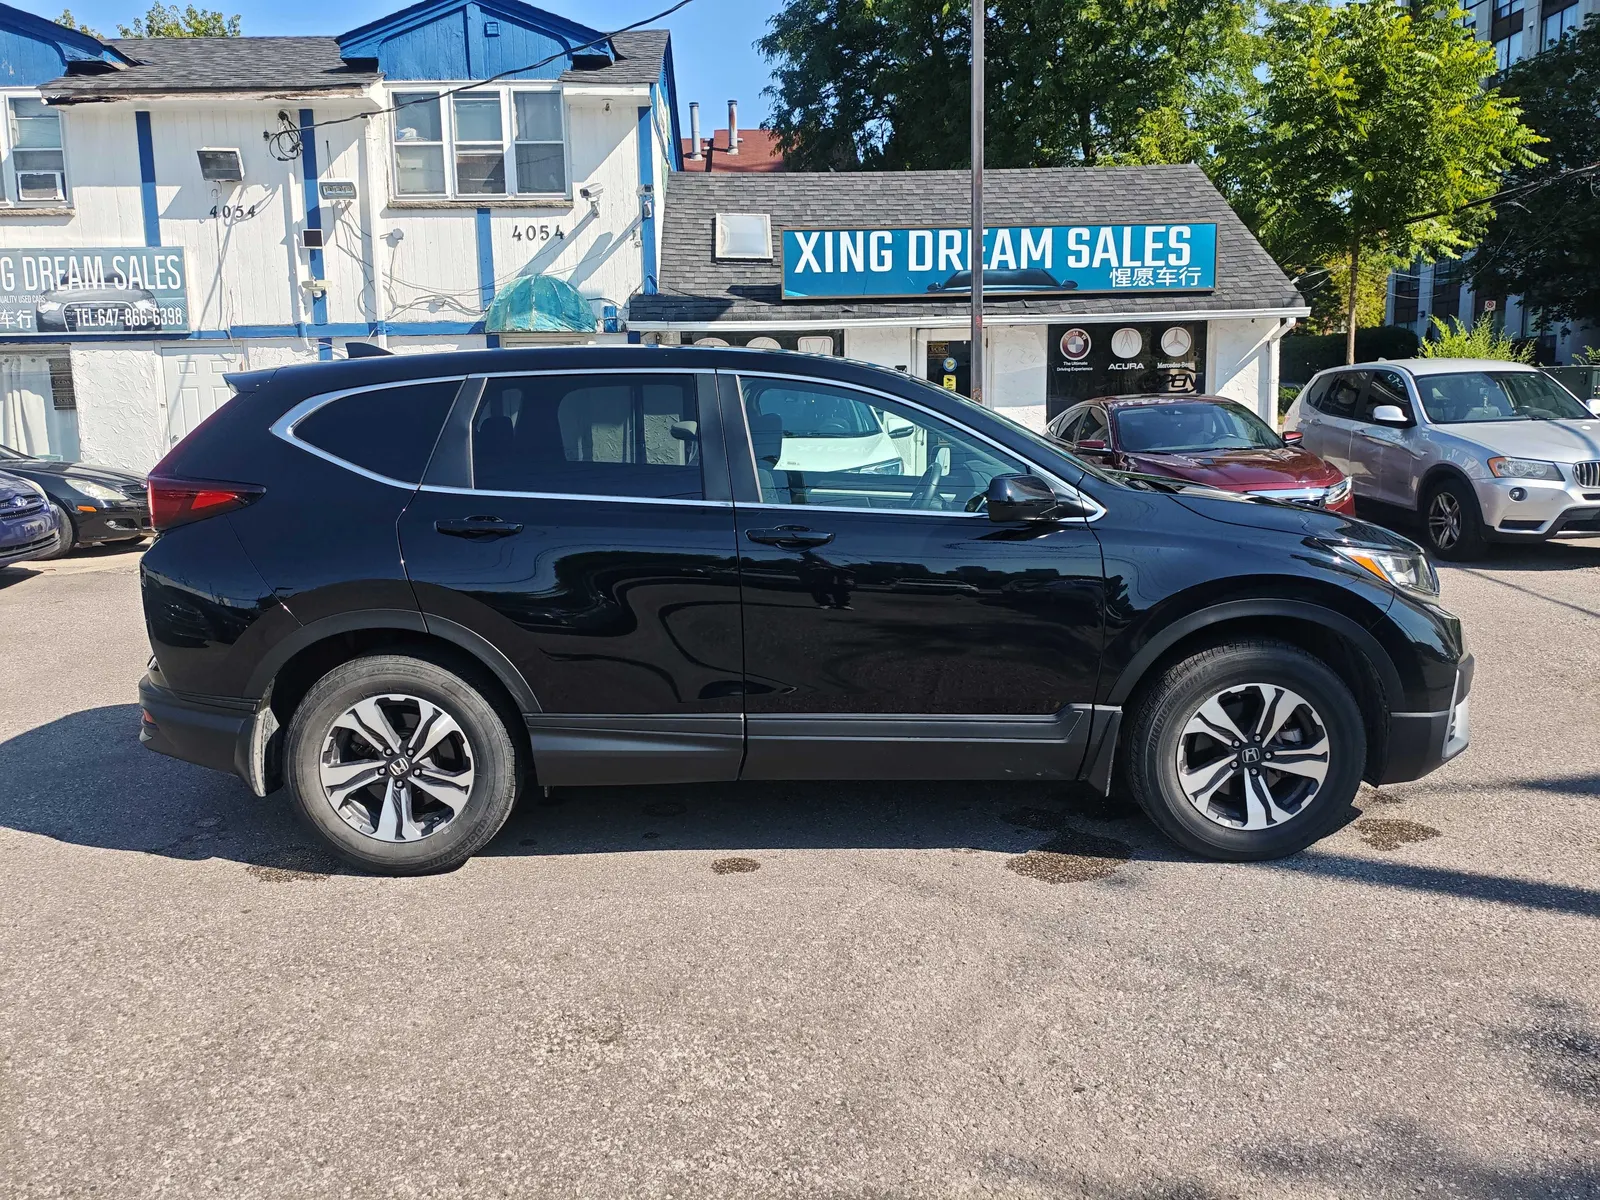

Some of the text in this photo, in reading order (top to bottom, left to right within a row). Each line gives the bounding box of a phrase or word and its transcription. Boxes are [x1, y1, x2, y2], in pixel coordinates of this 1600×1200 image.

[209, 204, 256, 219] 4054
[512, 224, 564, 241] 4054
[793, 230, 893, 274] XING
[1067, 225, 1191, 269] SALES
[22, 255, 106, 291] DREAM
[113, 254, 182, 291] SALES
[1109, 266, 1202, 288] 惺愿车行
[0, 295, 17, 304] UALITY
[74, 307, 183, 327] TEL:647-866-6398
[1108, 362, 1145, 370] ACURA
[1156, 361, 1195, 370] Mercedes-Be
